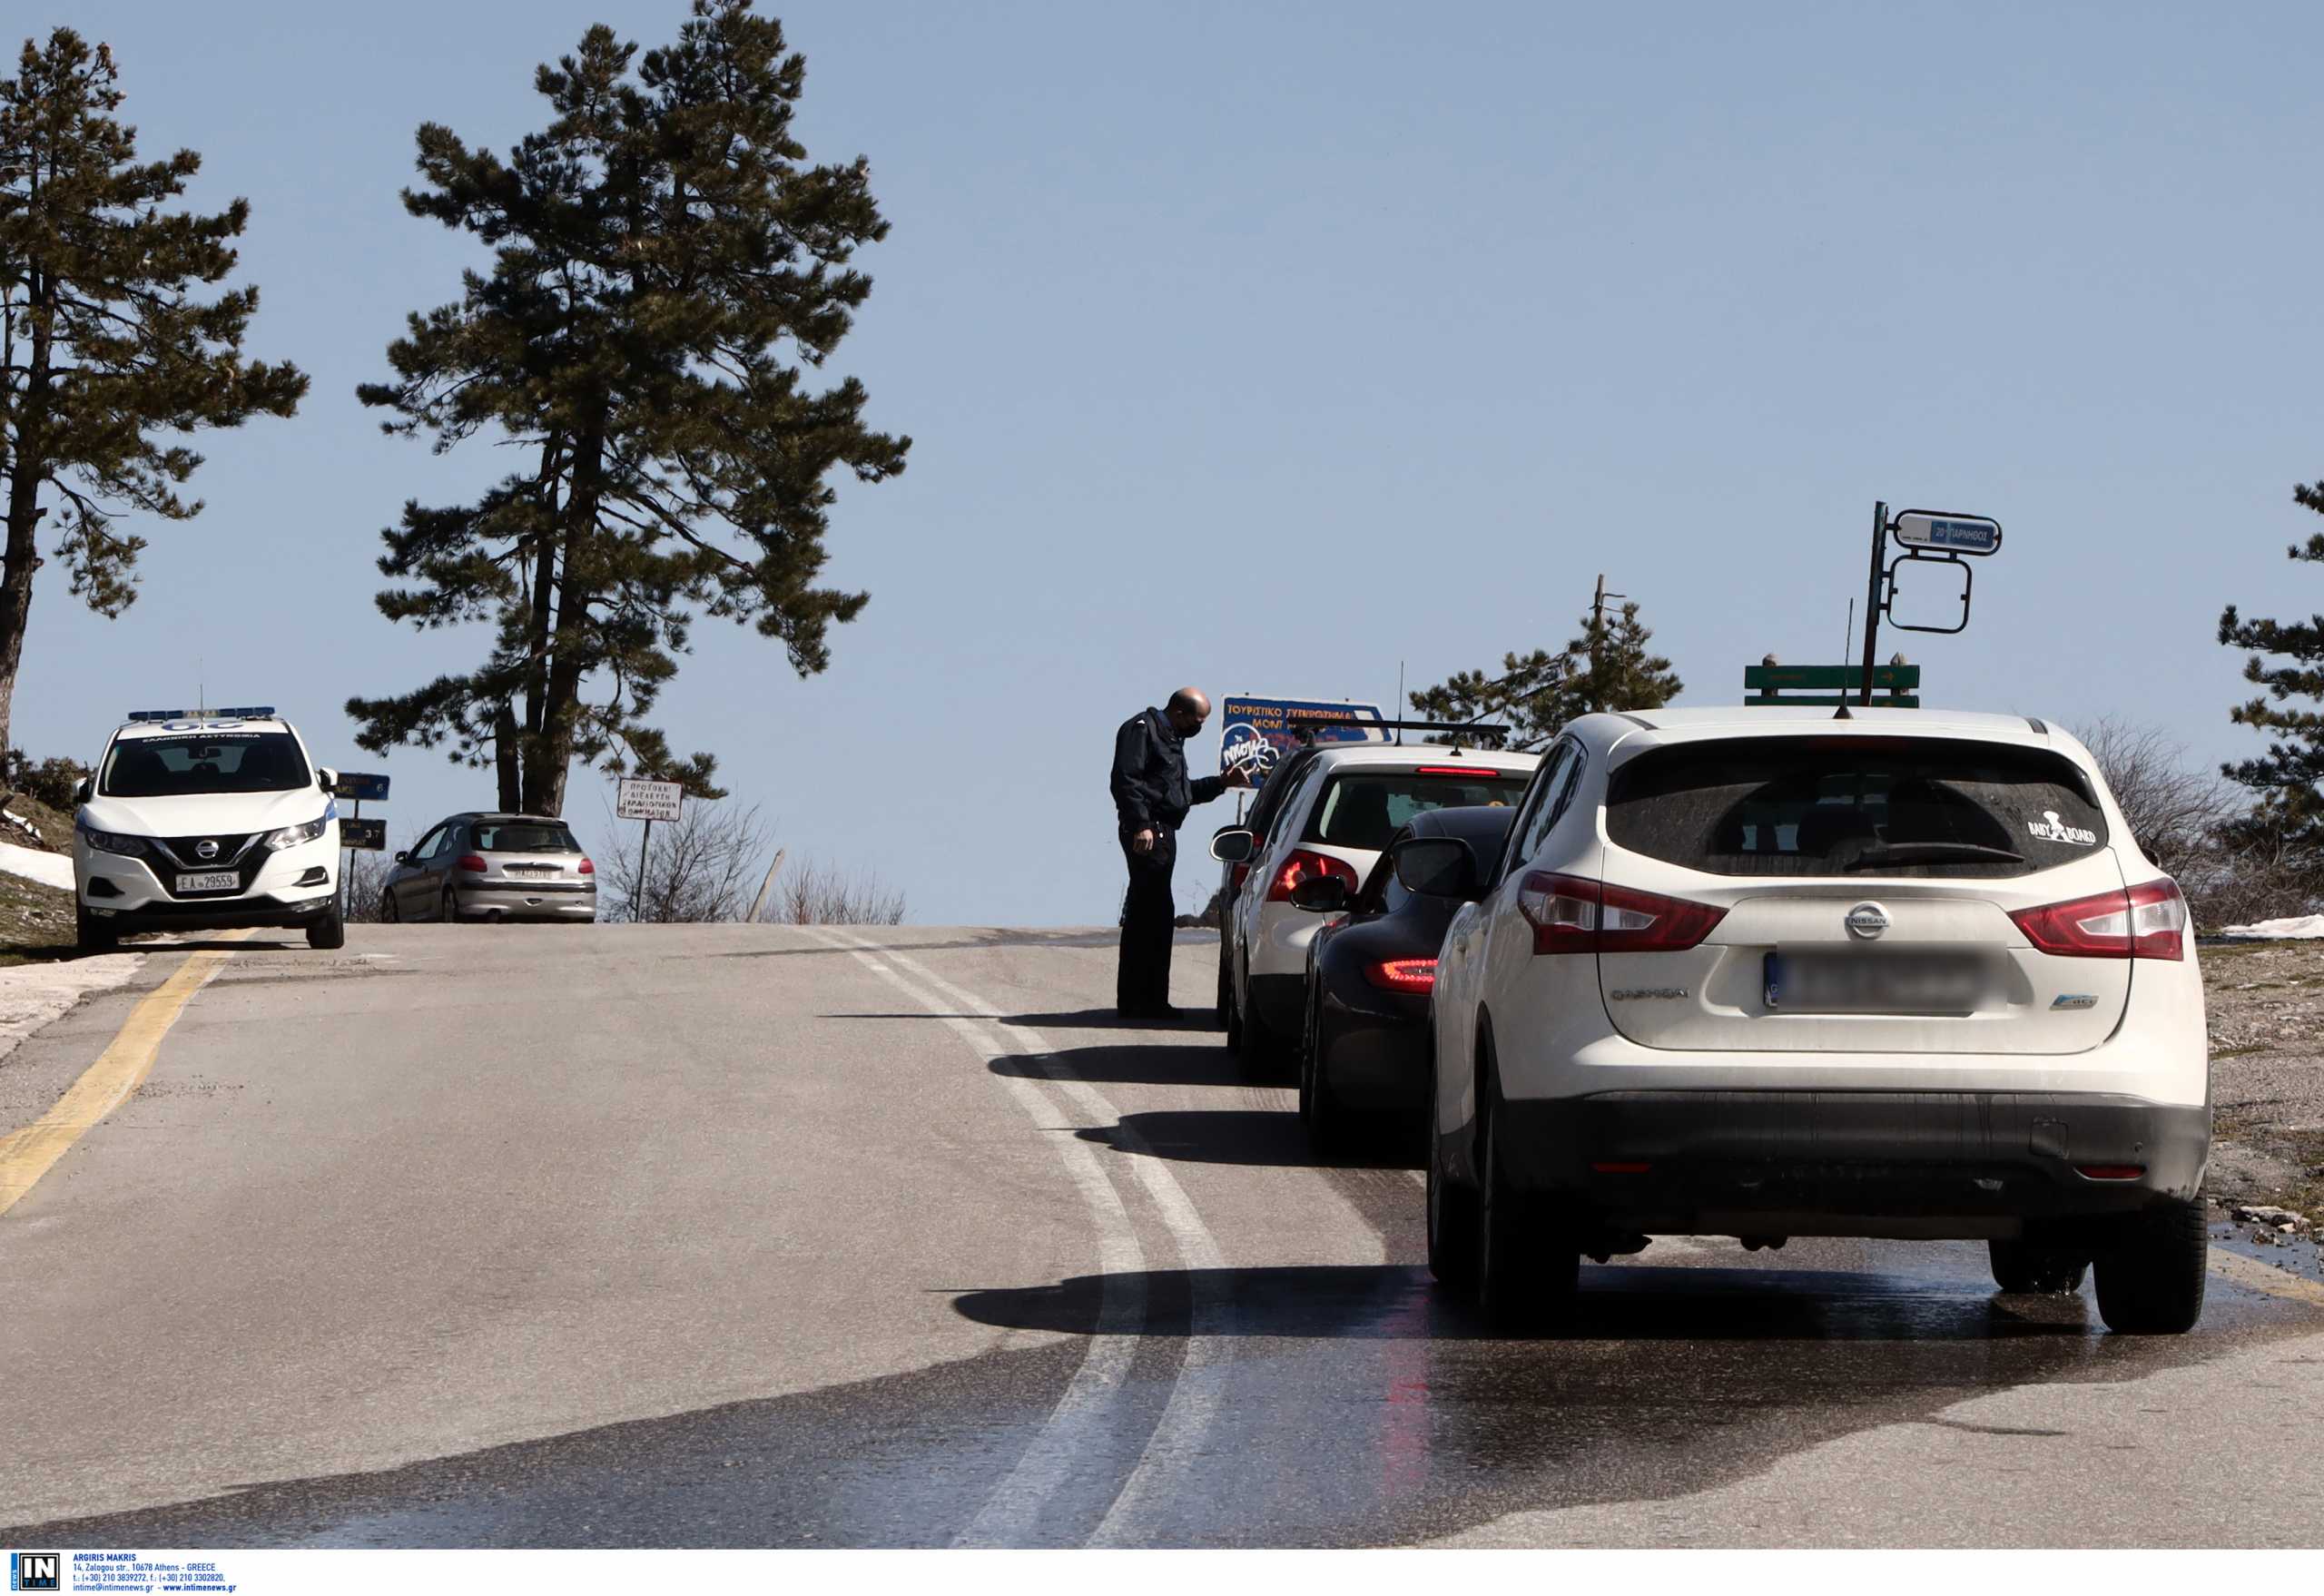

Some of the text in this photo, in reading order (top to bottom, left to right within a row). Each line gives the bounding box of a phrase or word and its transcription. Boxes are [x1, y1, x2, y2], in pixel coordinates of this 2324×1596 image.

[1227, 704, 1283, 717] ΤΟΥΡΙΣΤΙΚΟ
[2028, 822, 2096, 843] BABY BOARD
[1851, 917, 1886, 925] NISSAN
